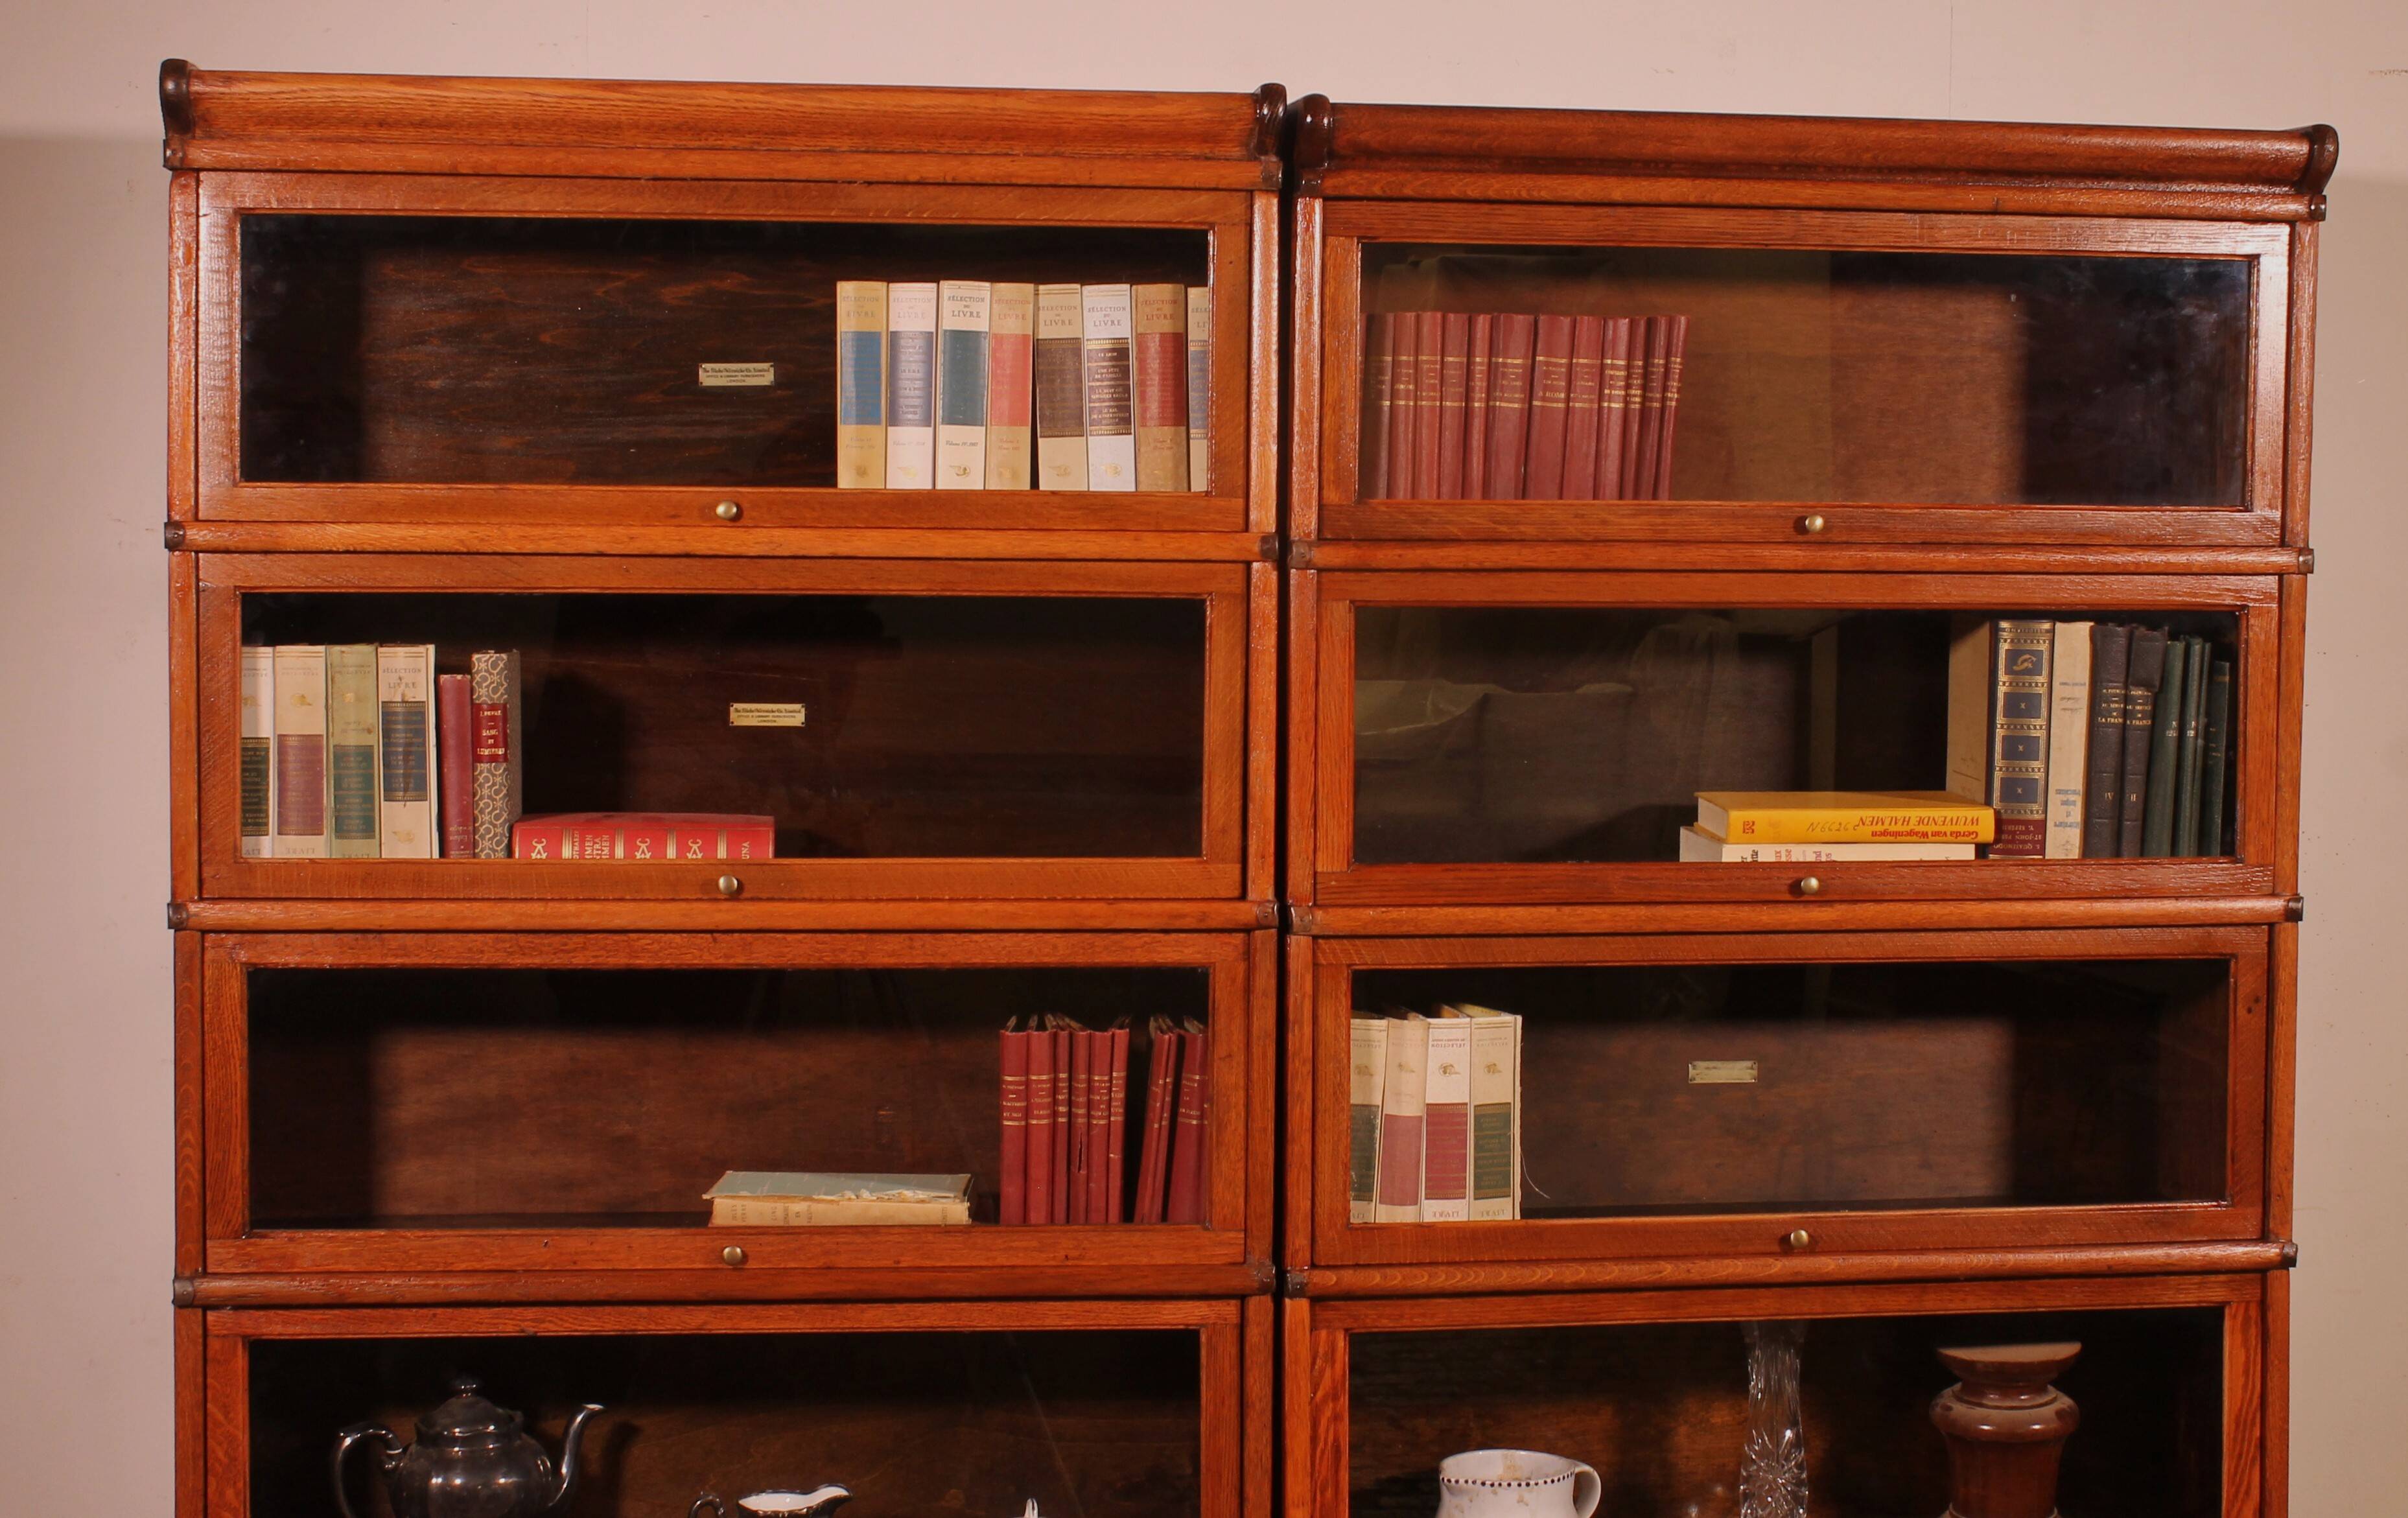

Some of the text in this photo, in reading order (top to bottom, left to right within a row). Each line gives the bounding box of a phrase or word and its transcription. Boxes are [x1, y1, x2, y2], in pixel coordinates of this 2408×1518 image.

[952, 310, 981, 318] LIVRE
[1145, 313, 1175, 321] LIVRE
[1858, 815, 1980, 826] WUIVENDE HALMEN
[1871, 828, 1930, 839] Wageningen
[1950, 829, 1980, 839] Gerda
[1431, 1210, 1460, 1219] LIVRE
